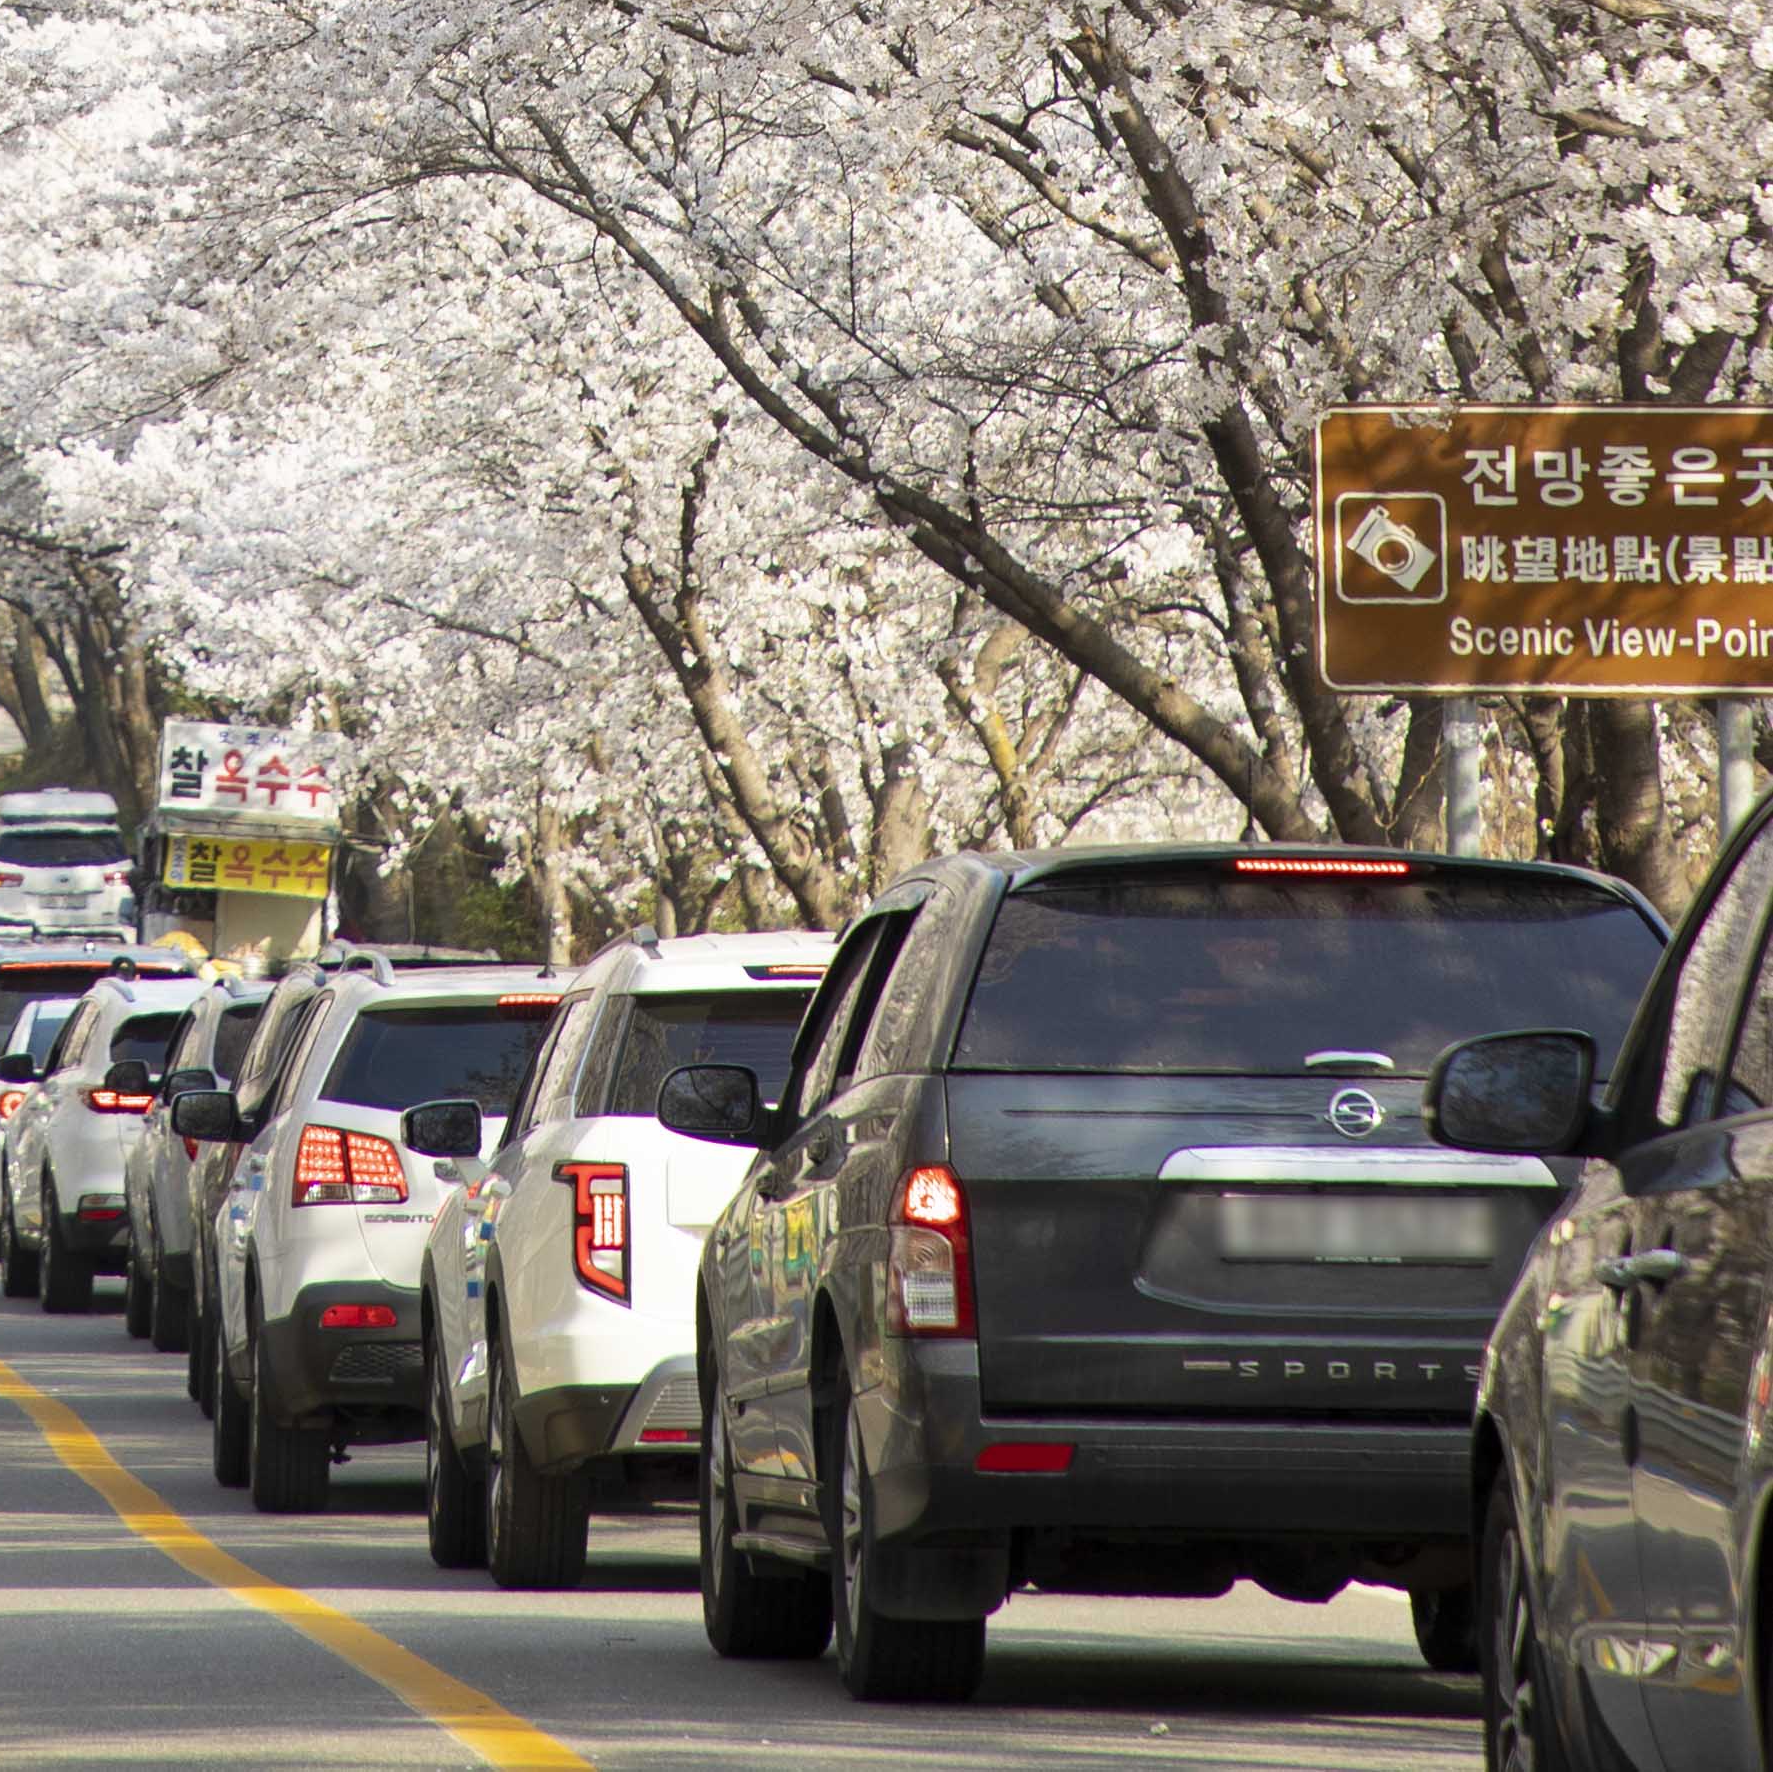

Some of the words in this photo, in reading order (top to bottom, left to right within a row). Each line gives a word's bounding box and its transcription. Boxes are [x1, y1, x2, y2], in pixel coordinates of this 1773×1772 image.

[1449, 617, 1575, 657] Scenic
[170, 746, 330, 808] 찰옥수수
[189, 841, 325, 889] 찰옥수수
[364, 1214, 436, 1223] SORENTO
[1238, 1361, 1482, 1382] SPORTS
